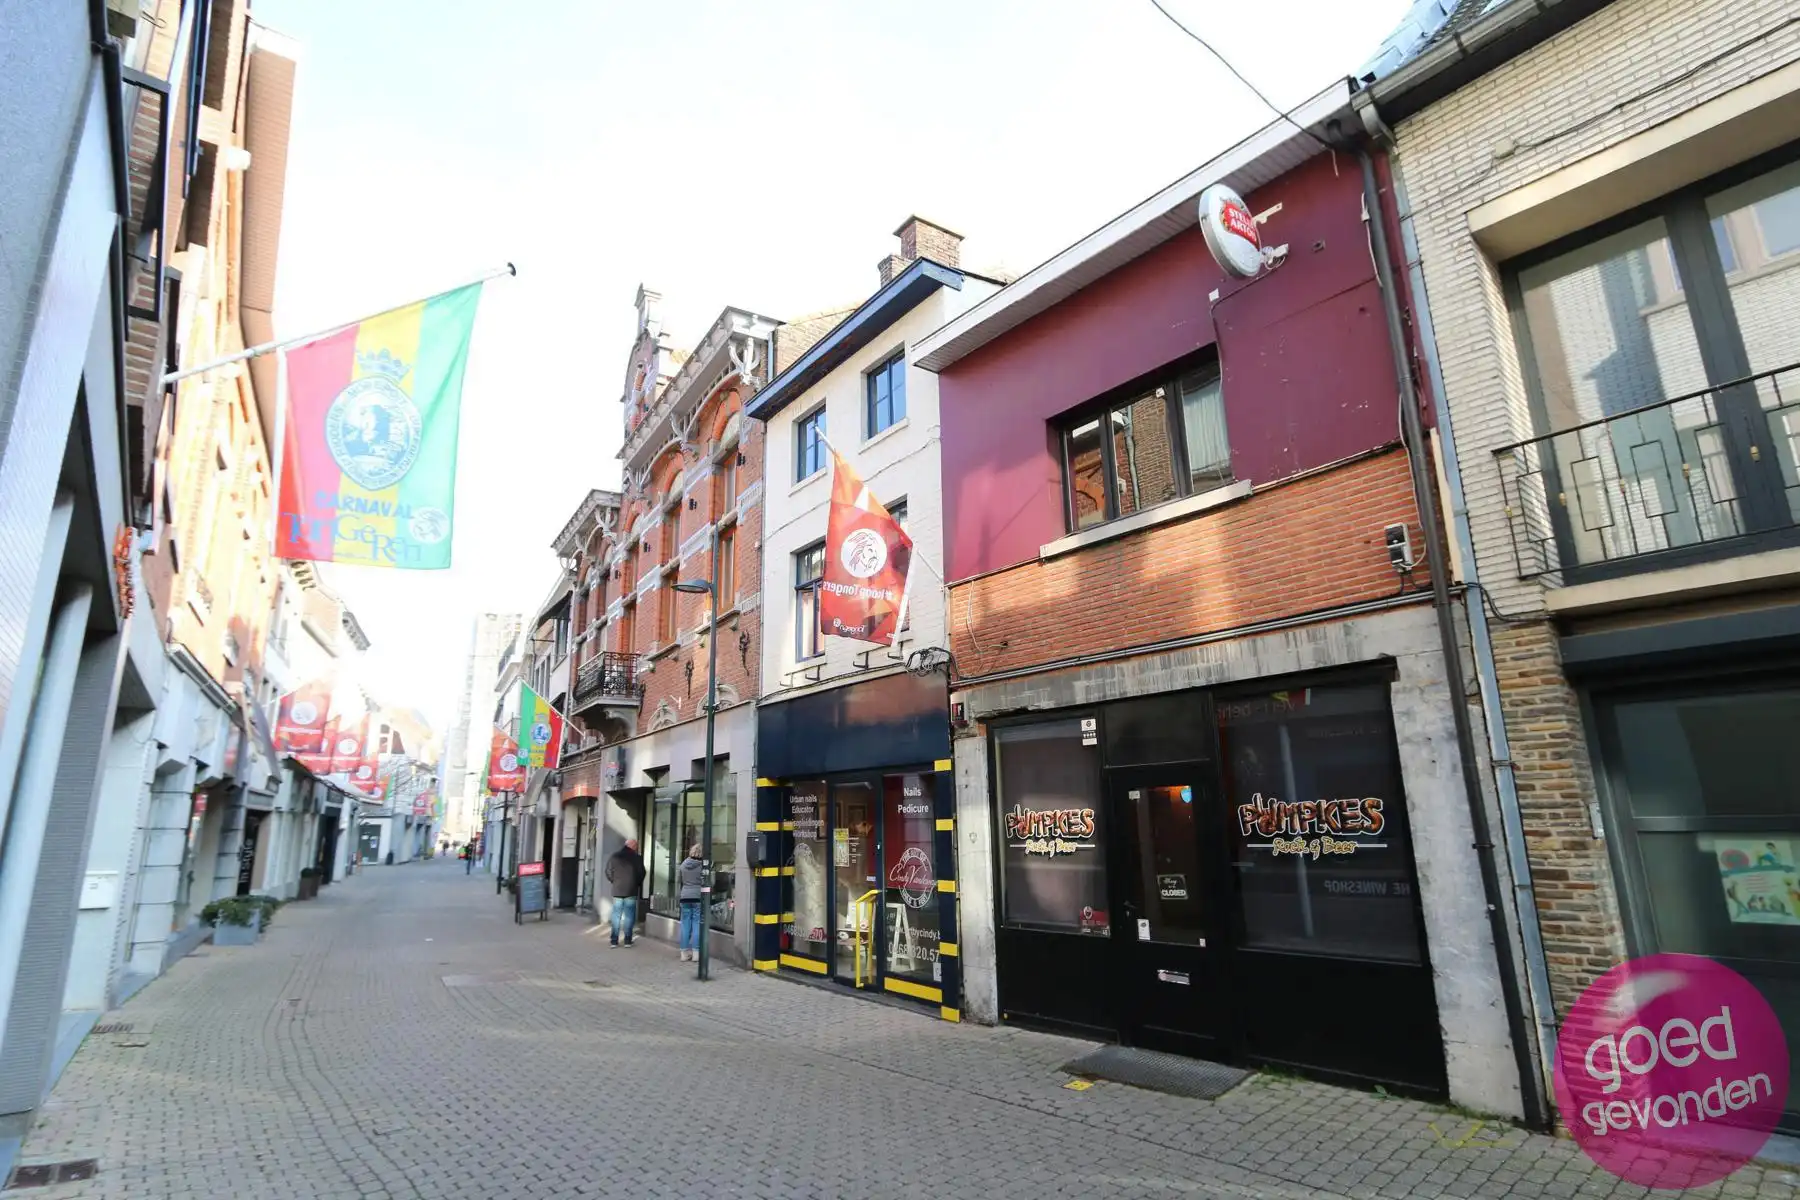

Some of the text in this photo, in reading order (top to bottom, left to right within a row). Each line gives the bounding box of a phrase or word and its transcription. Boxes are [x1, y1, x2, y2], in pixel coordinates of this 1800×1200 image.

[315, 490, 414, 519] CARNAVAL
[903, 787, 922, 797] Nails
[789, 795, 804, 804] Urban
[791, 805, 815, 814] Educator
[897, 803, 929, 815] Pedicure
[1024, 838, 1049, 855] Rock
[1055, 838, 1078, 853] Beer
[1272, 836, 1309, 856] Rock
[1321, 836, 1358, 854] Beer
[889, 863, 910, 886] Cindy
[1161, 889, 1186, 897] CLOSED
